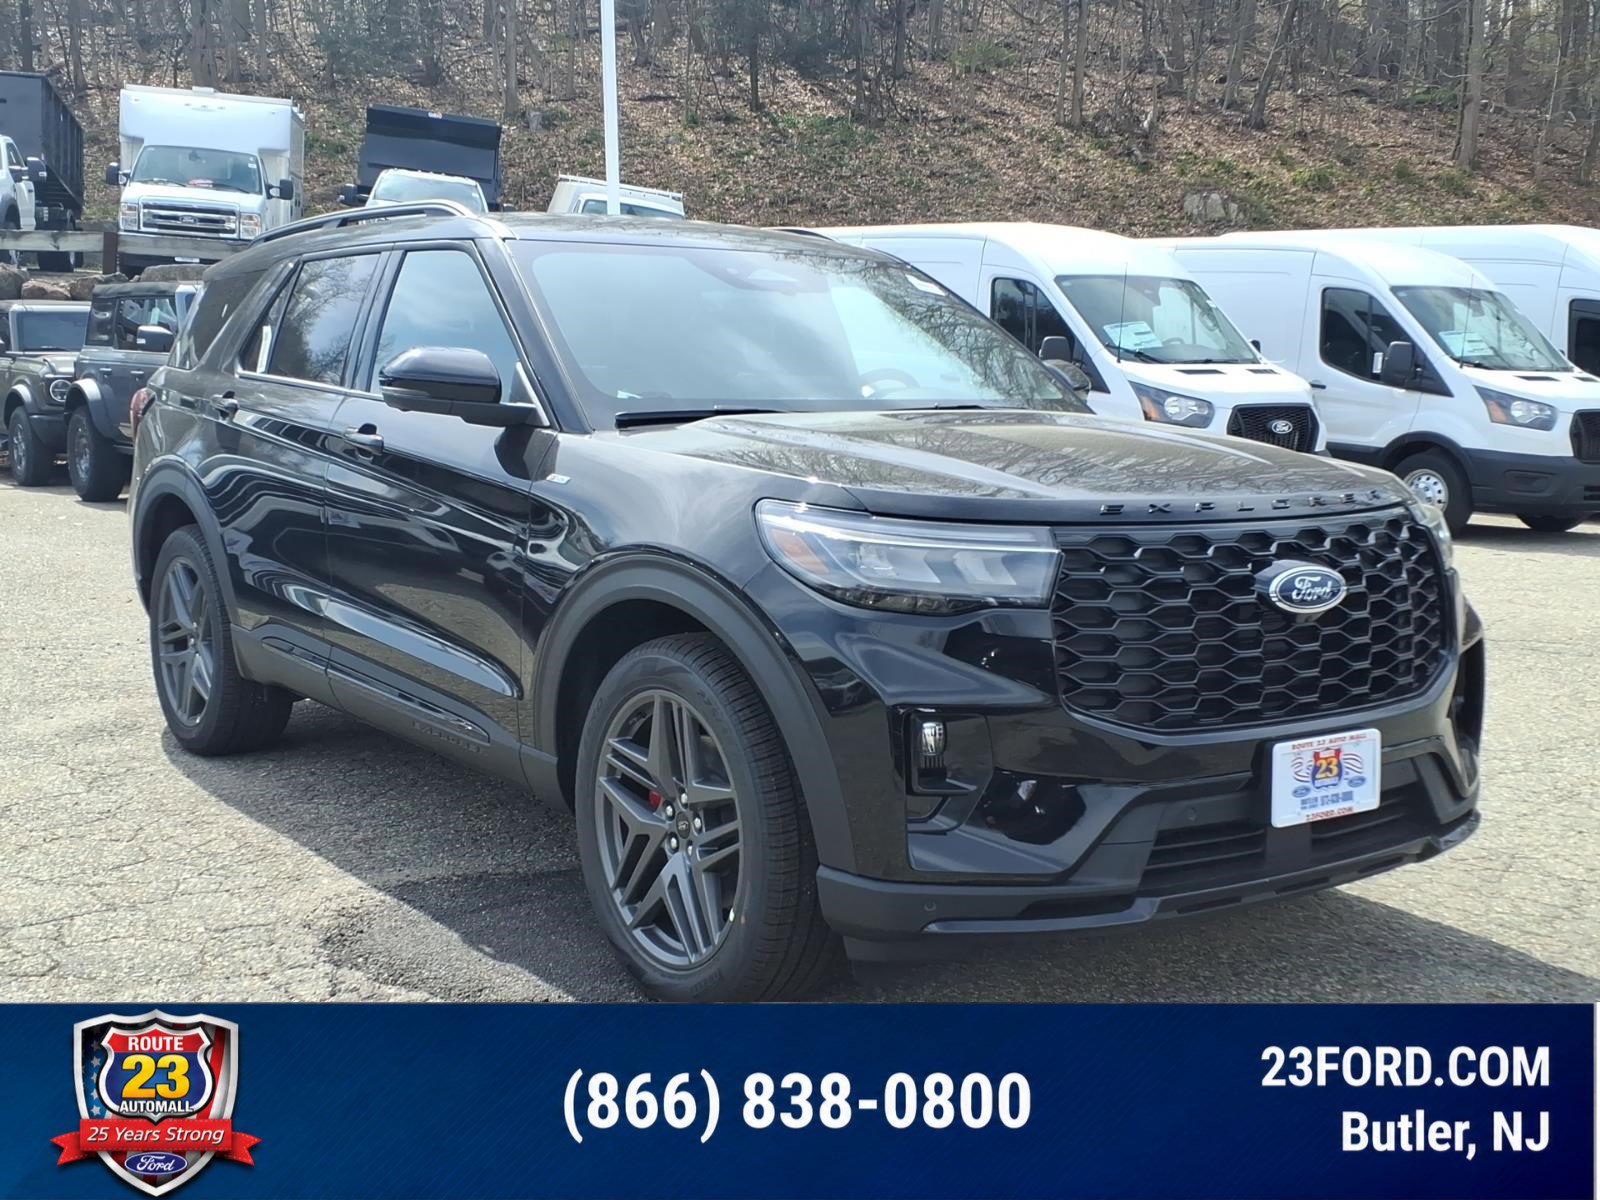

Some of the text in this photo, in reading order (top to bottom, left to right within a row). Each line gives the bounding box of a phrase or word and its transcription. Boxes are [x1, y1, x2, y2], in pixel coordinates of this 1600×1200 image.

[1100, 489, 1384, 514] EXPLORER
[1292, 575, 1333, 601] Ford
[1315, 758, 1339, 779] 23
